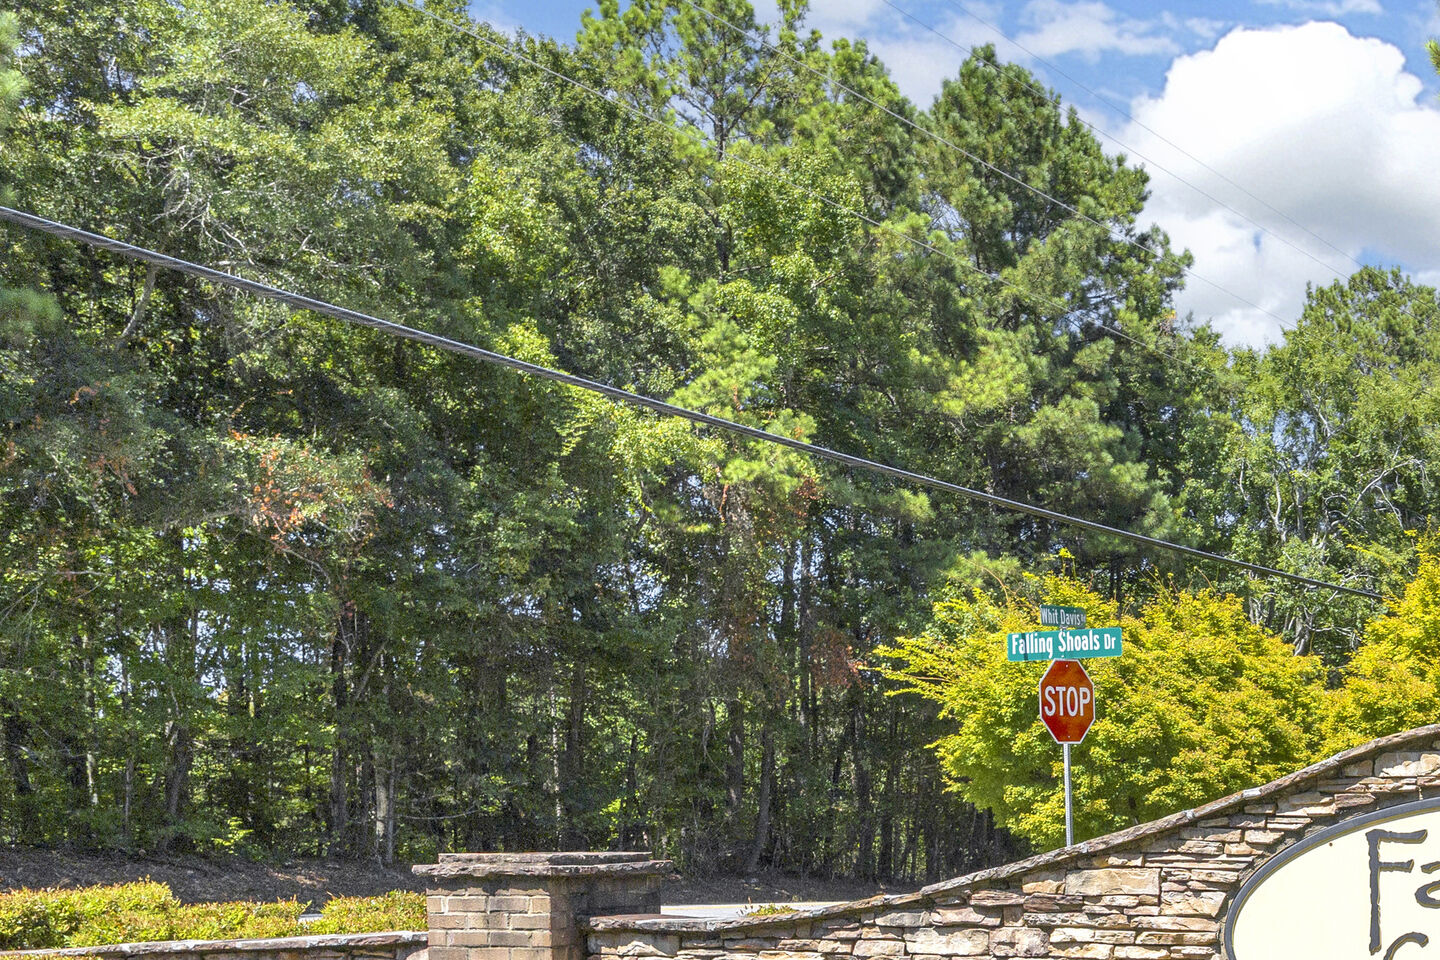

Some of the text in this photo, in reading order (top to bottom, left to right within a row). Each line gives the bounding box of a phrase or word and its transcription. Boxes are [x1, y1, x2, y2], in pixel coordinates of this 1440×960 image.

[1041, 607, 1058, 624] Whit
[1061, 609, 1081, 626] Davis
[1012, 629, 1116, 659] Falling Shoals Dr
[1044, 686, 1091, 717] STOP
